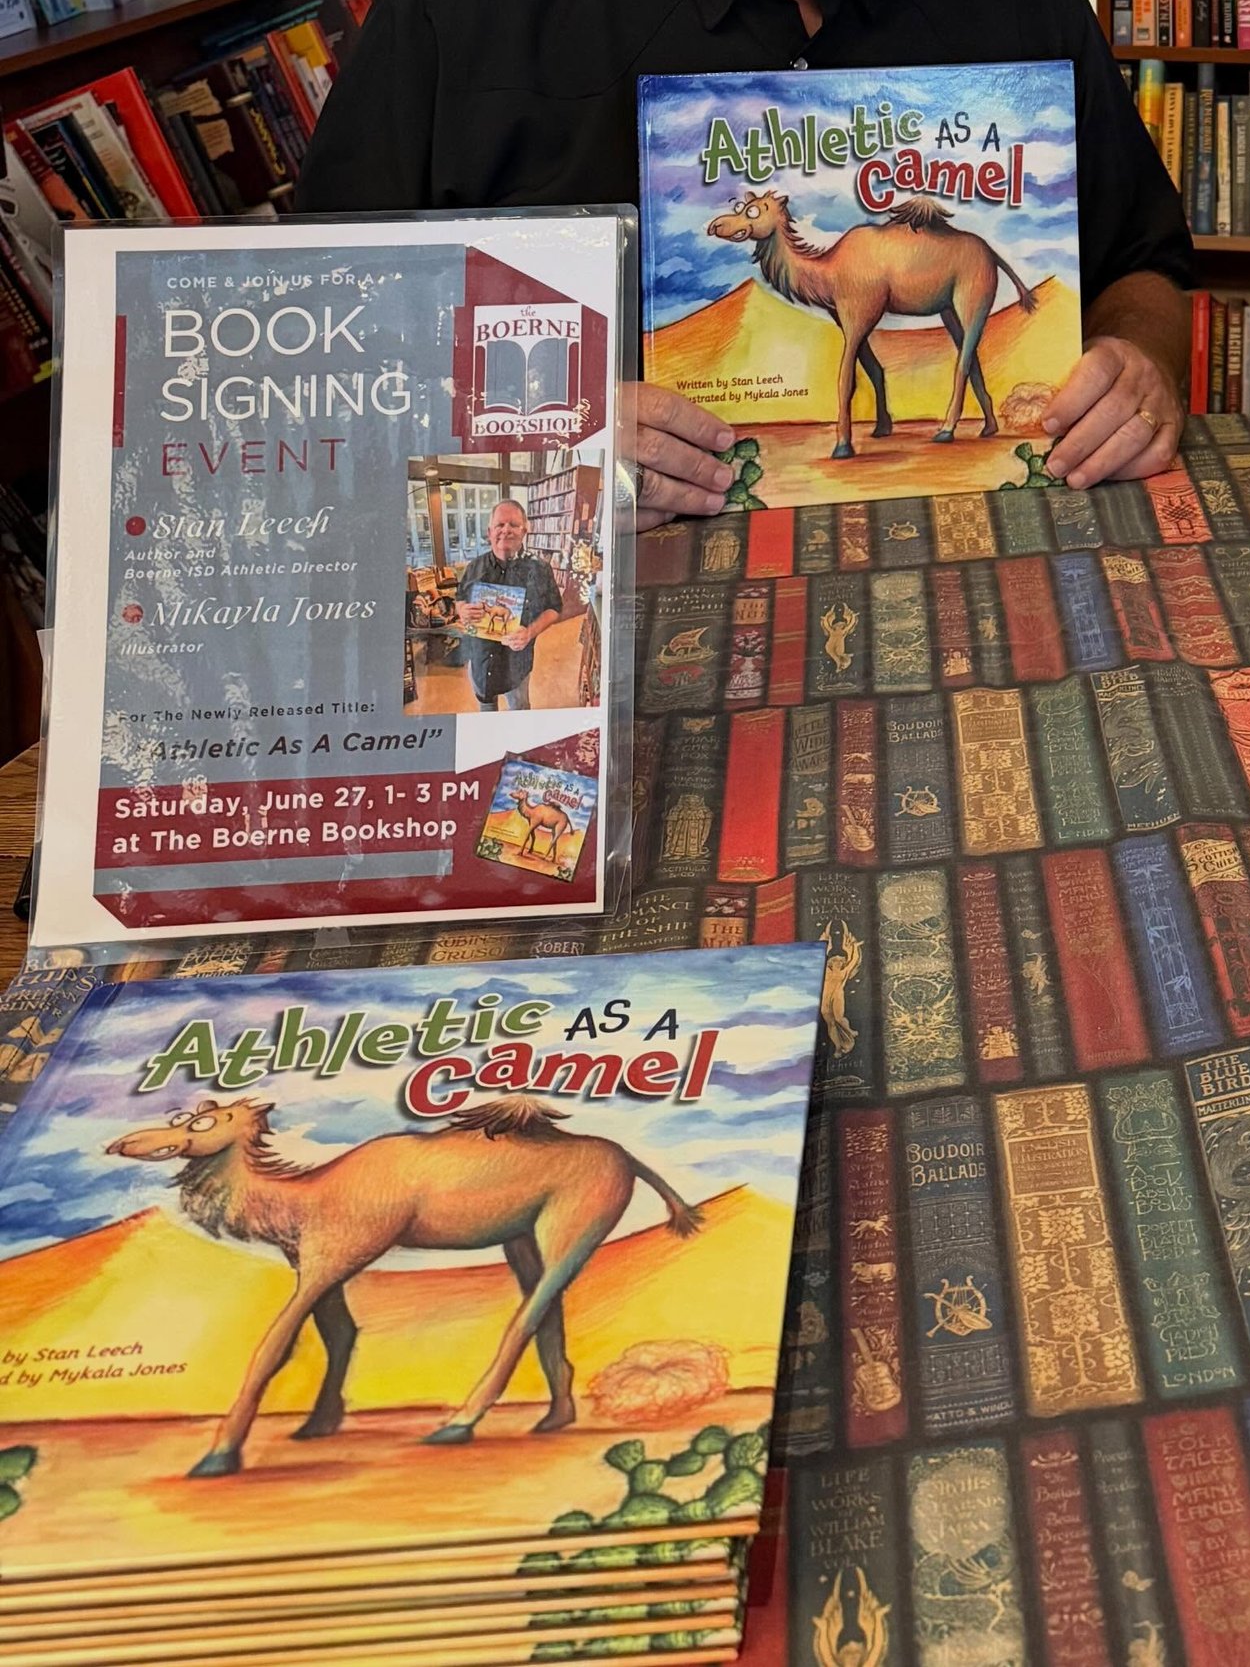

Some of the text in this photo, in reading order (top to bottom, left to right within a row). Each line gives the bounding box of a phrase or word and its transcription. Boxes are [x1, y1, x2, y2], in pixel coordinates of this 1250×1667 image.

[701, 101, 1000, 184] Athletic AS A
[857, 143, 1025, 213] Camel
[167, 274, 375, 289] COME & JOIN US FOR A
[520, 304, 537, 320] the
[164, 304, 367, 359] BOOK
[476, 317, 581, 343] BOERNE
[676, 375, 784, 390] Written by Stan Leech
[160, 373, 412, 422] SIGNING
[730, 391, 742, 404] by
[745, 388, 779, 402] Mykala
[781, 387, 808, 398] Jones
[161, 437, 347, 477] EVENT
[153, 504, 332, 539] Stan Leech
[125, 547, 216, 562] Author and
[124, 558, 358, 580] Boerne ISD Athletic Director
[150, 595, 377, 632] Mikayla Jones
[119, 640, 204, 657] Illustrator
[154, 706, 184, 723] The
[191, 705, 242, 723] Newly
[250, 702, 325, 720] Released
[332, 700, 376, 716] Title:
[268, 733, 303, 756] As
[312, 734, 332, 755] A
[115, 781, 481, 821] Saturday, June 27, 1- 3 PM
[113, 818, 458, 855] at The Boerne Bookshop
[139, 992, 681, 1094] Athletic AS A
[399, 1025, 722, 1121] Camel
[1200, 1064, 1250, 1086] BLUE
[1202, 1054, 1241, 1073] THE
[909, 1162, 987, 1187] BALLADS
[3, 1341, 145, 1366] by Stan Leech
[17, 1358, 188, 1388] by Mykala Jones
